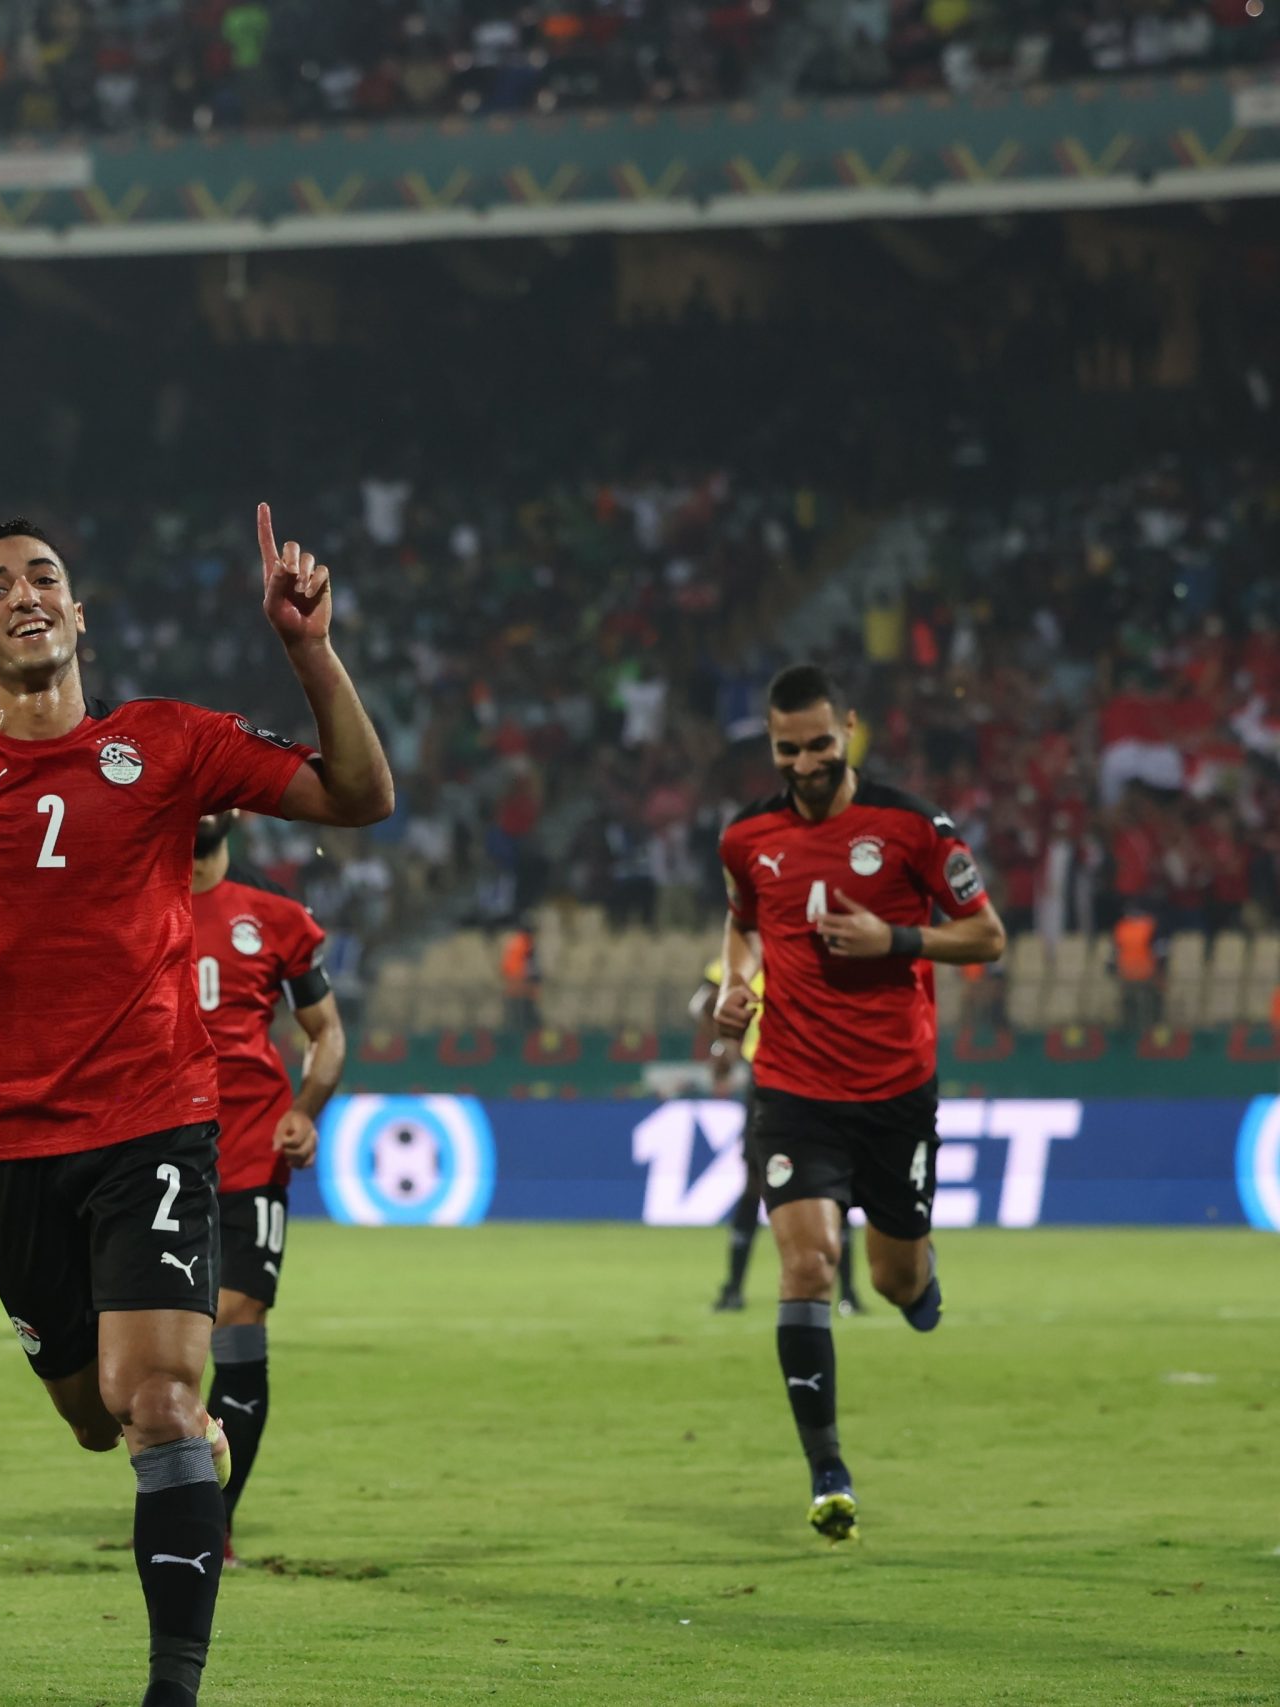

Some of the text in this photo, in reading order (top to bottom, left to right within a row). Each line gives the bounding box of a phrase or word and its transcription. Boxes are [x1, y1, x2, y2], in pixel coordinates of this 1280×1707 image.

[37, 794, 66, 868] 2
[198, 955, 220, 1012] 0
[632, 1099, 1084, 1228] 1XET
[909, 1140, 927, 1191] 4
[152, 1163, 181, 1232] 2
[254, 1195, 285, 1254] 10
